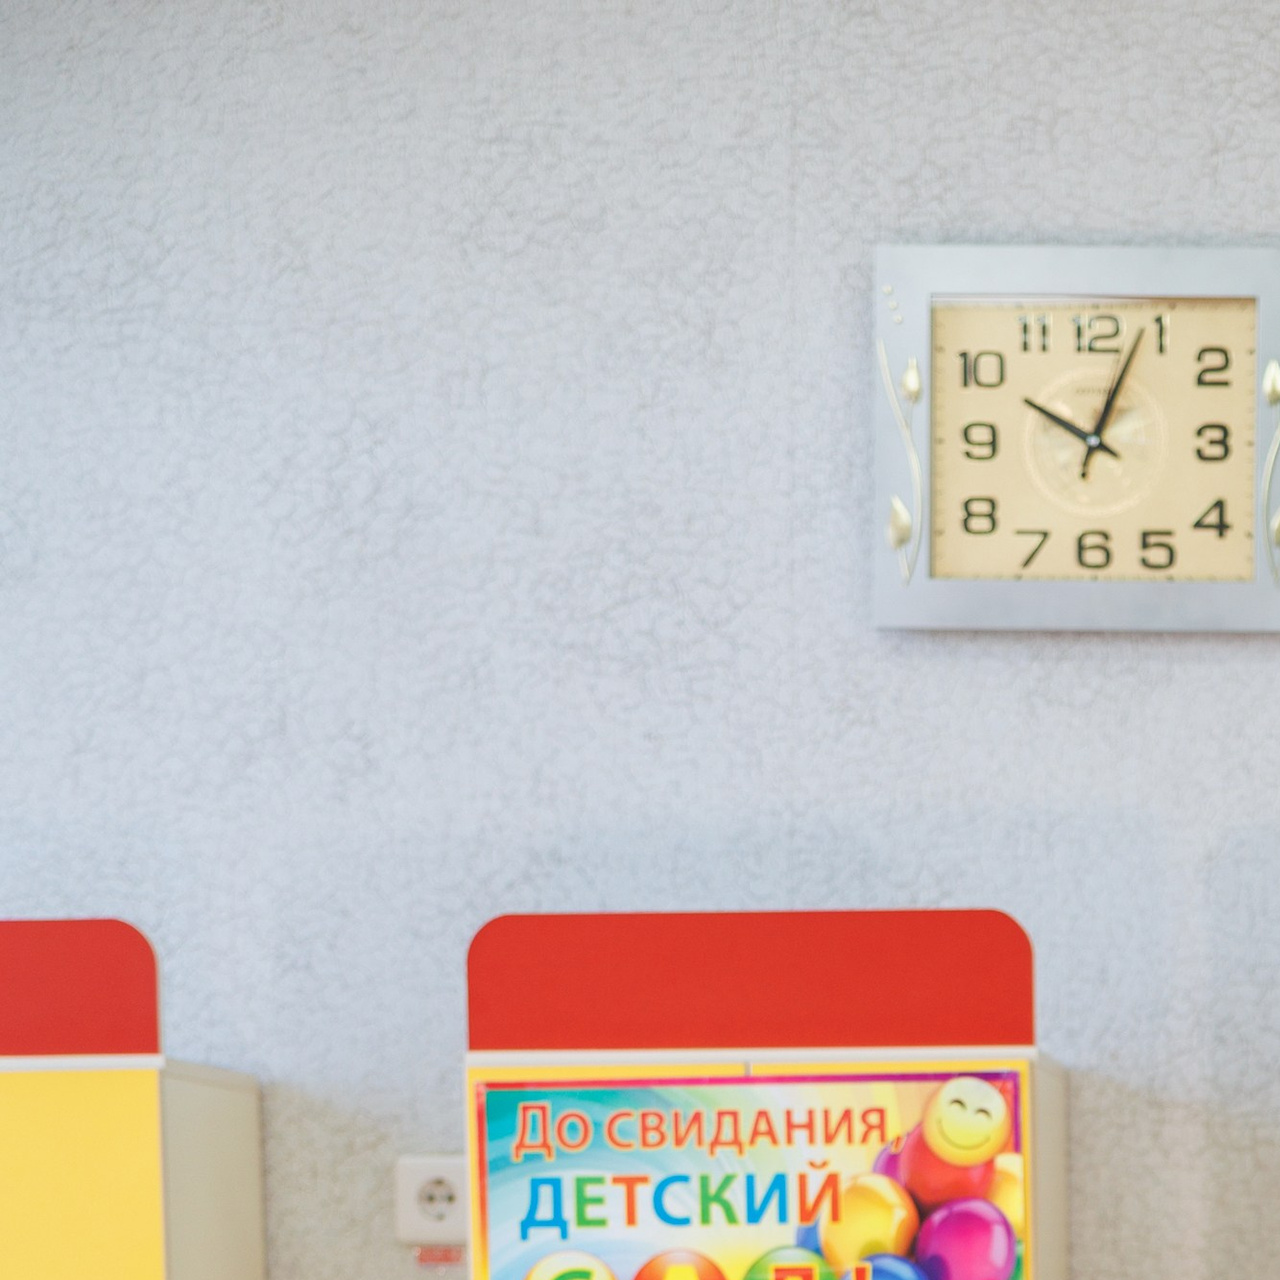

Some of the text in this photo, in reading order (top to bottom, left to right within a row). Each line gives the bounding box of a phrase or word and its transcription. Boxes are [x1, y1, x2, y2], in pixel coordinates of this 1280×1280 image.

[1018, 315, 1052, 353] 11
[1072, 314, 1121, 354] 12
[1155, 315, 1169, 354] 1
[958, 350, 1007, 389] 10
[1195, 347, 1231, 386] 2
[962, 422, 998, 461] 9
[1195, 423, 1230, 461] 3
[962, 496, 998, 535] 8
[1193, 499, 1231, 538] 4
[1014, 530, 1050, 568] 7
[1076, 530, 1111, 569] 6
[1140, 530, 1175, 569] 5
[606, 1108, 901, 1157] СВИДАНИЯ,
[520, 1160, 841, 1241] ДЕТСКИЙ
